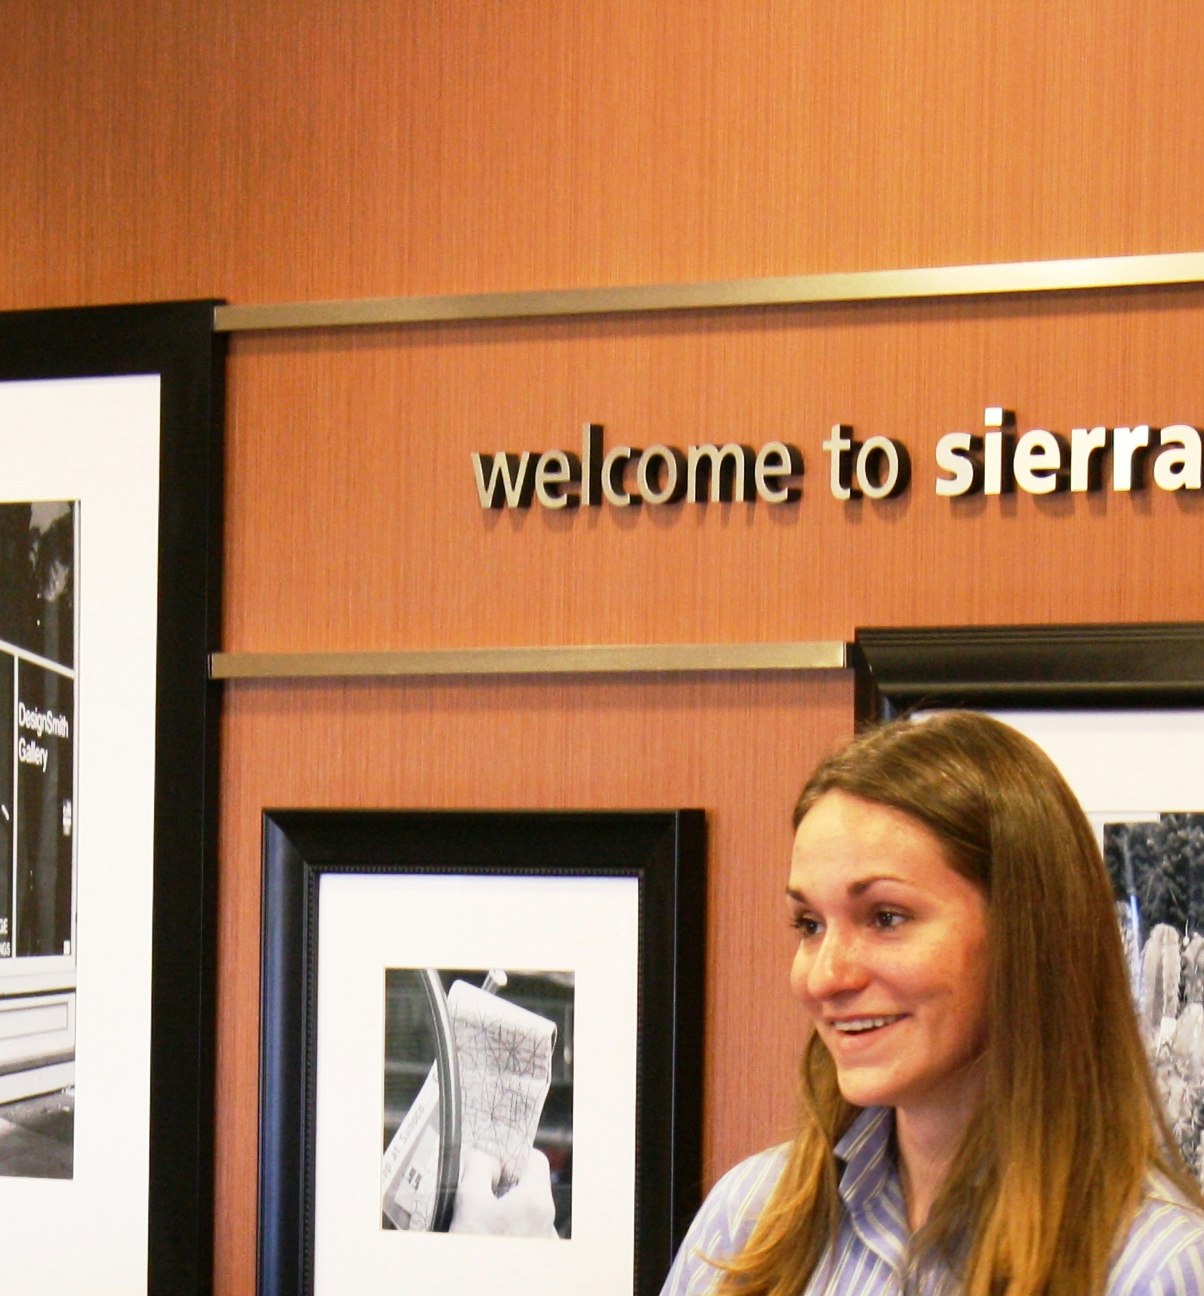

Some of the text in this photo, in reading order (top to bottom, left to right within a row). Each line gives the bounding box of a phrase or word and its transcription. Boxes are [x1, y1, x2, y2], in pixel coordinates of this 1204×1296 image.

[471, 422, 796, 509] welcome
[823, 423, 902, 501] to
[935, 406, 1204, 497] sierra
[18, 701, 69, 738] DesignSmith
[18, 737, 48, 772] Gallery
